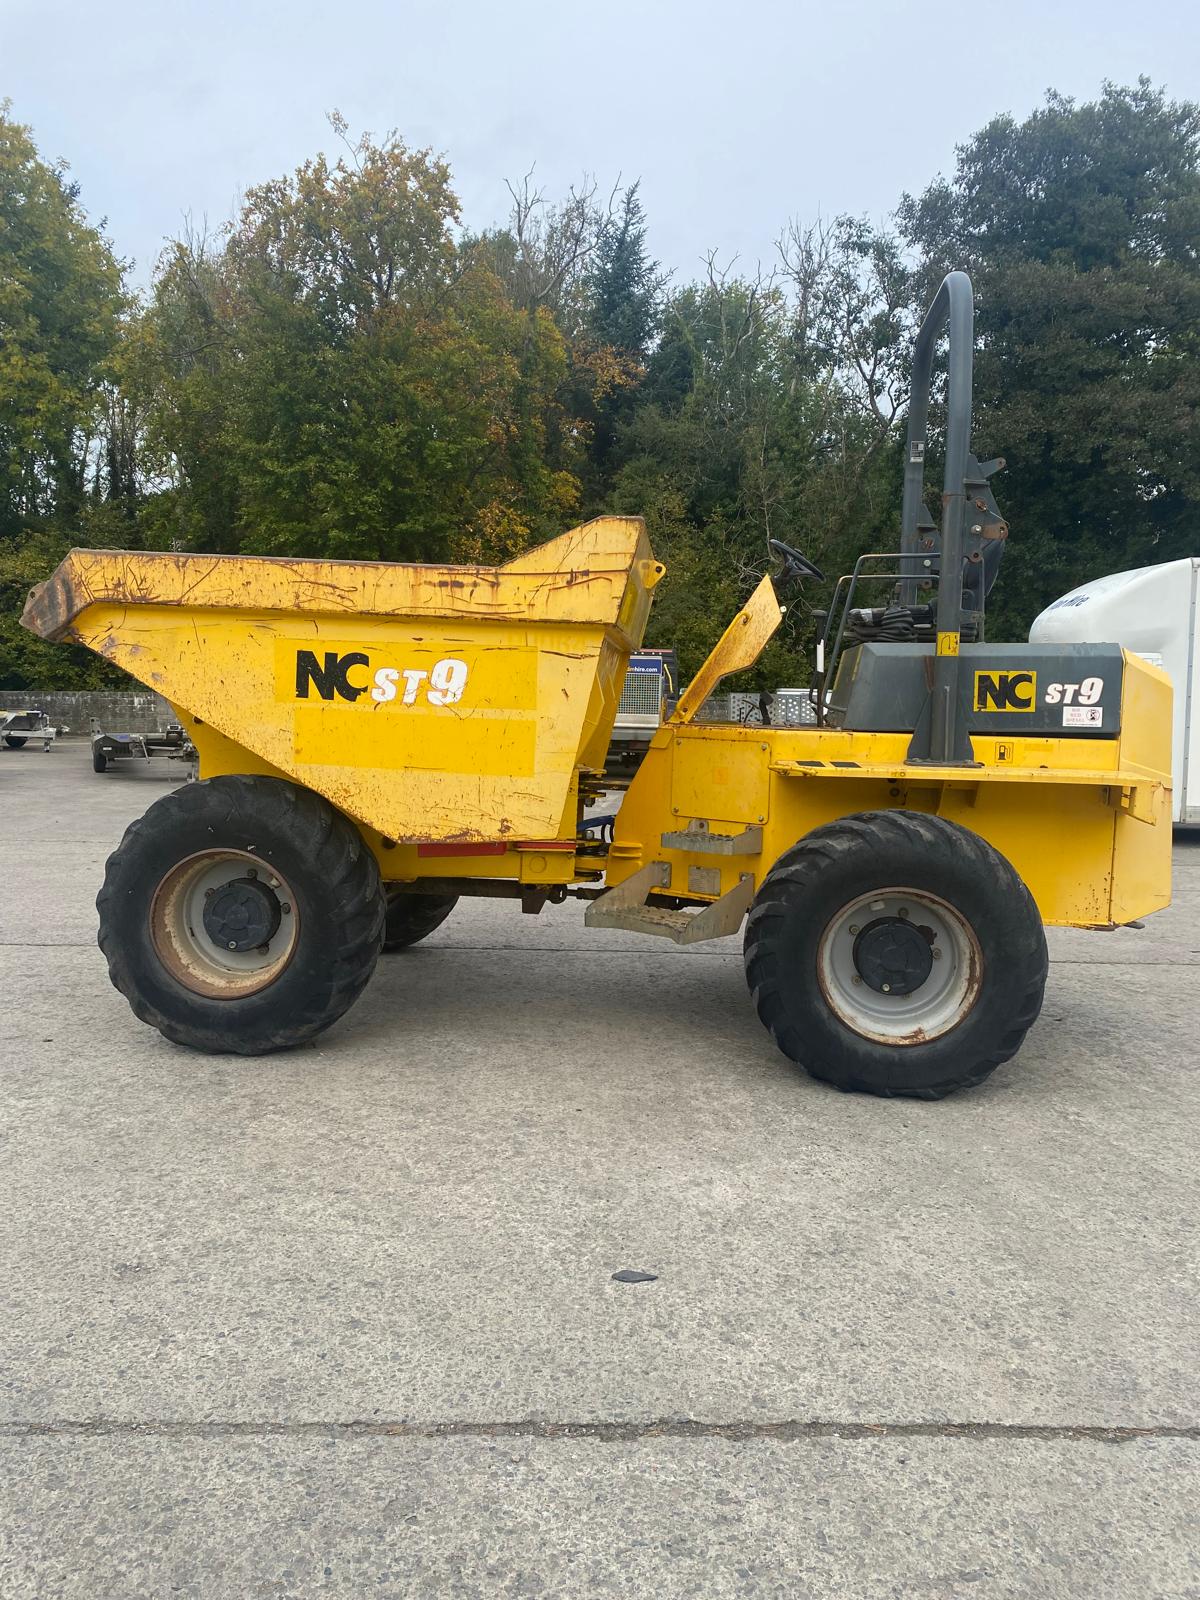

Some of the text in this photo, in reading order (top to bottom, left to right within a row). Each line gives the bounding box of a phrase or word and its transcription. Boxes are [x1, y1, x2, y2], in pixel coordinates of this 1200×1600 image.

[296, 650, 468, 706] NC ST9
[978, 674, 1104, 709] NC ST9
